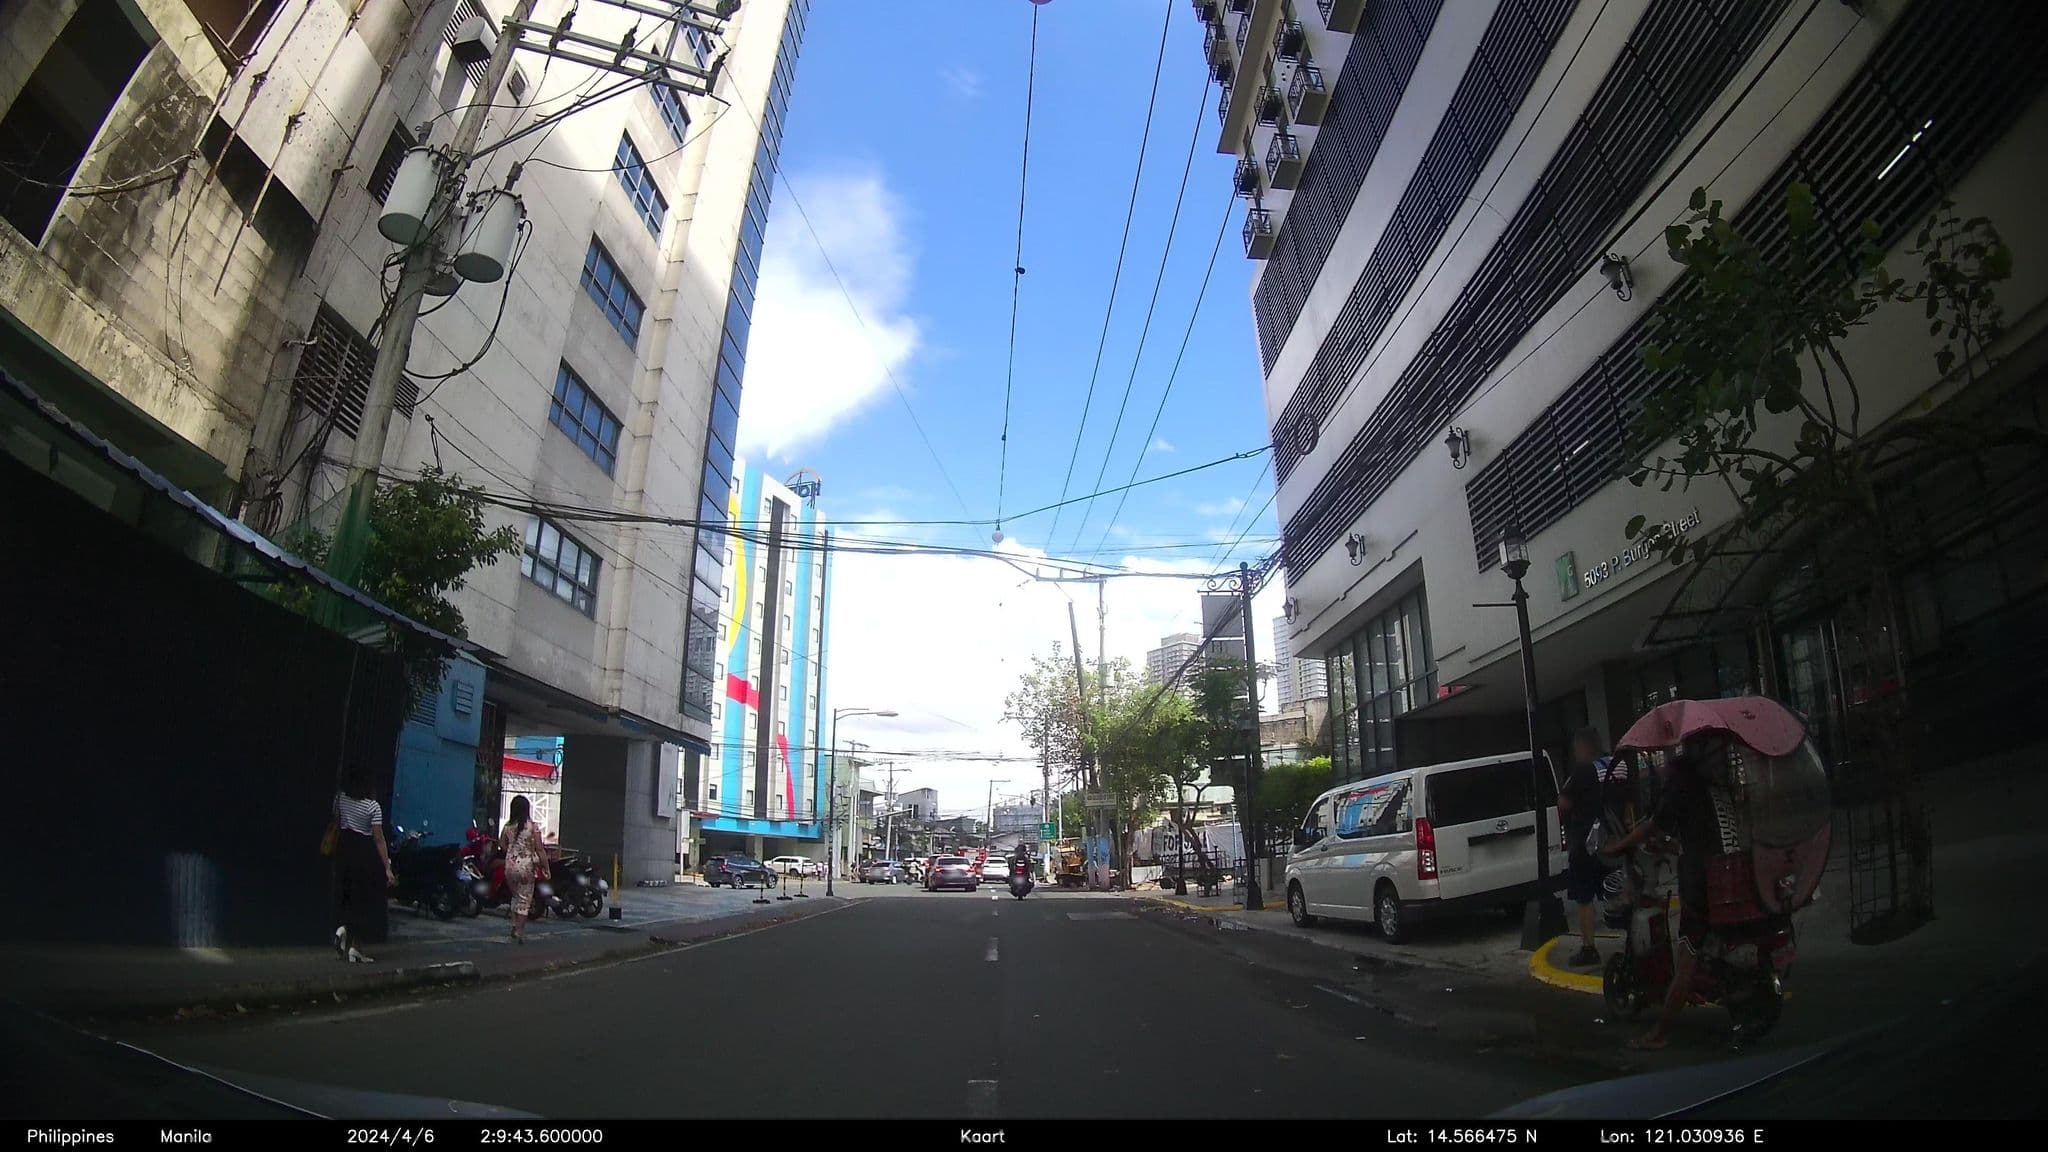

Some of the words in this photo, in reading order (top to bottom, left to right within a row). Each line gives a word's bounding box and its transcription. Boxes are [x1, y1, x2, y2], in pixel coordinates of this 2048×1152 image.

[1583, 561, 1610, 588] 5093
[1611, 556, 1623, 574] P.
[1662, 509, 1701, 540] Street
